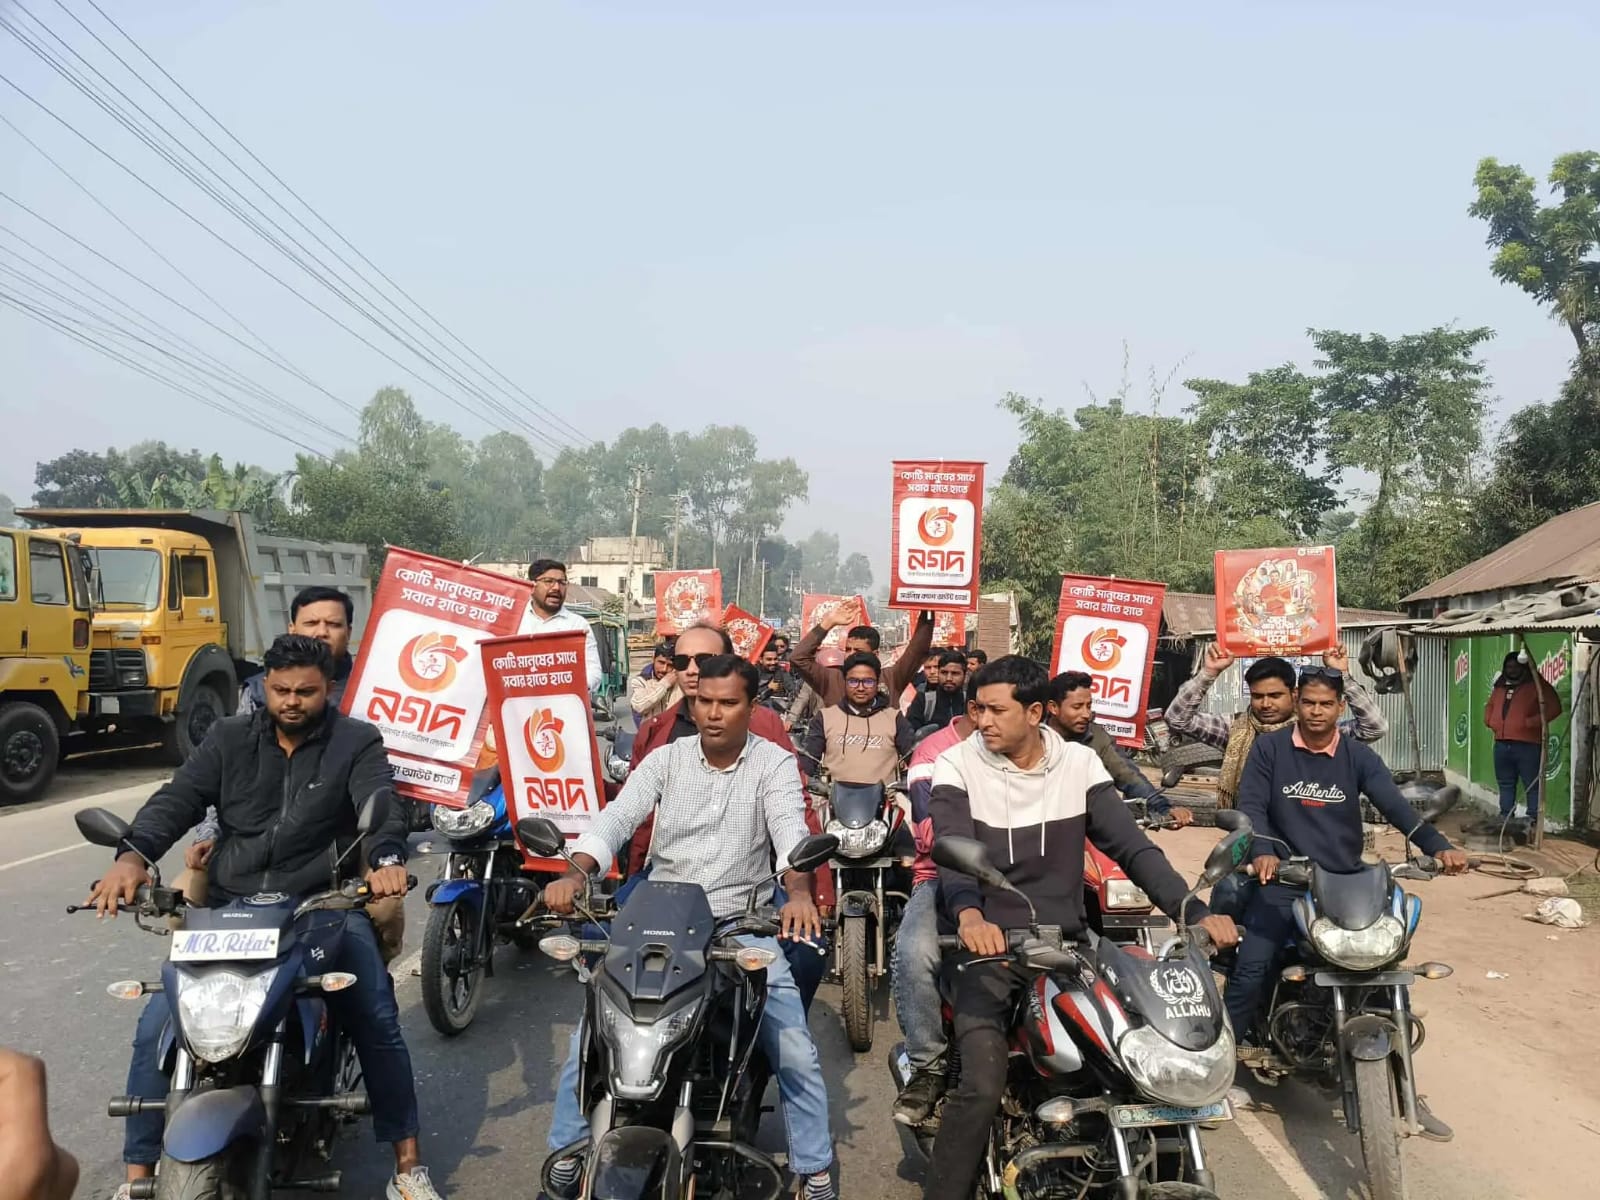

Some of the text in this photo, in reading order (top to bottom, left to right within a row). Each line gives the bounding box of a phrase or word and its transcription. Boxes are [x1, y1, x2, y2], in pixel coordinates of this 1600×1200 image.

[901, 469, 976, 483] কোটি মানুষের সাথে
[907, 483, 968, 494] সবার হাতে হাতে
[908, 549, 965, 572] নগদ
[395, 568, 516, 609] কোটি মানুষের সাথে
[1070, 585, 1154, 605] কোটি মানুষের সাথে
[401, 587, 499, 624] সবার হাতে হাতে
[1076, 599, 1144, 617] সবার হাতে হাতে
[492, 651, 578, 672] কোটি মানুষের সাথে
[502, 670, 572, 688] সবার হাতে হাতে
[1091, 673, 1131, 702] গদ
[366, 686, 466, 740] নগদ
[402, 765, 433, 781] আউট
[524, 777, 589, 811] নগদ
[1282, 781, 1346, 800] Authentic
[222, 932, 271, 956] Rifat
[1165, 1004, 1211, 1019] ALLAHU
